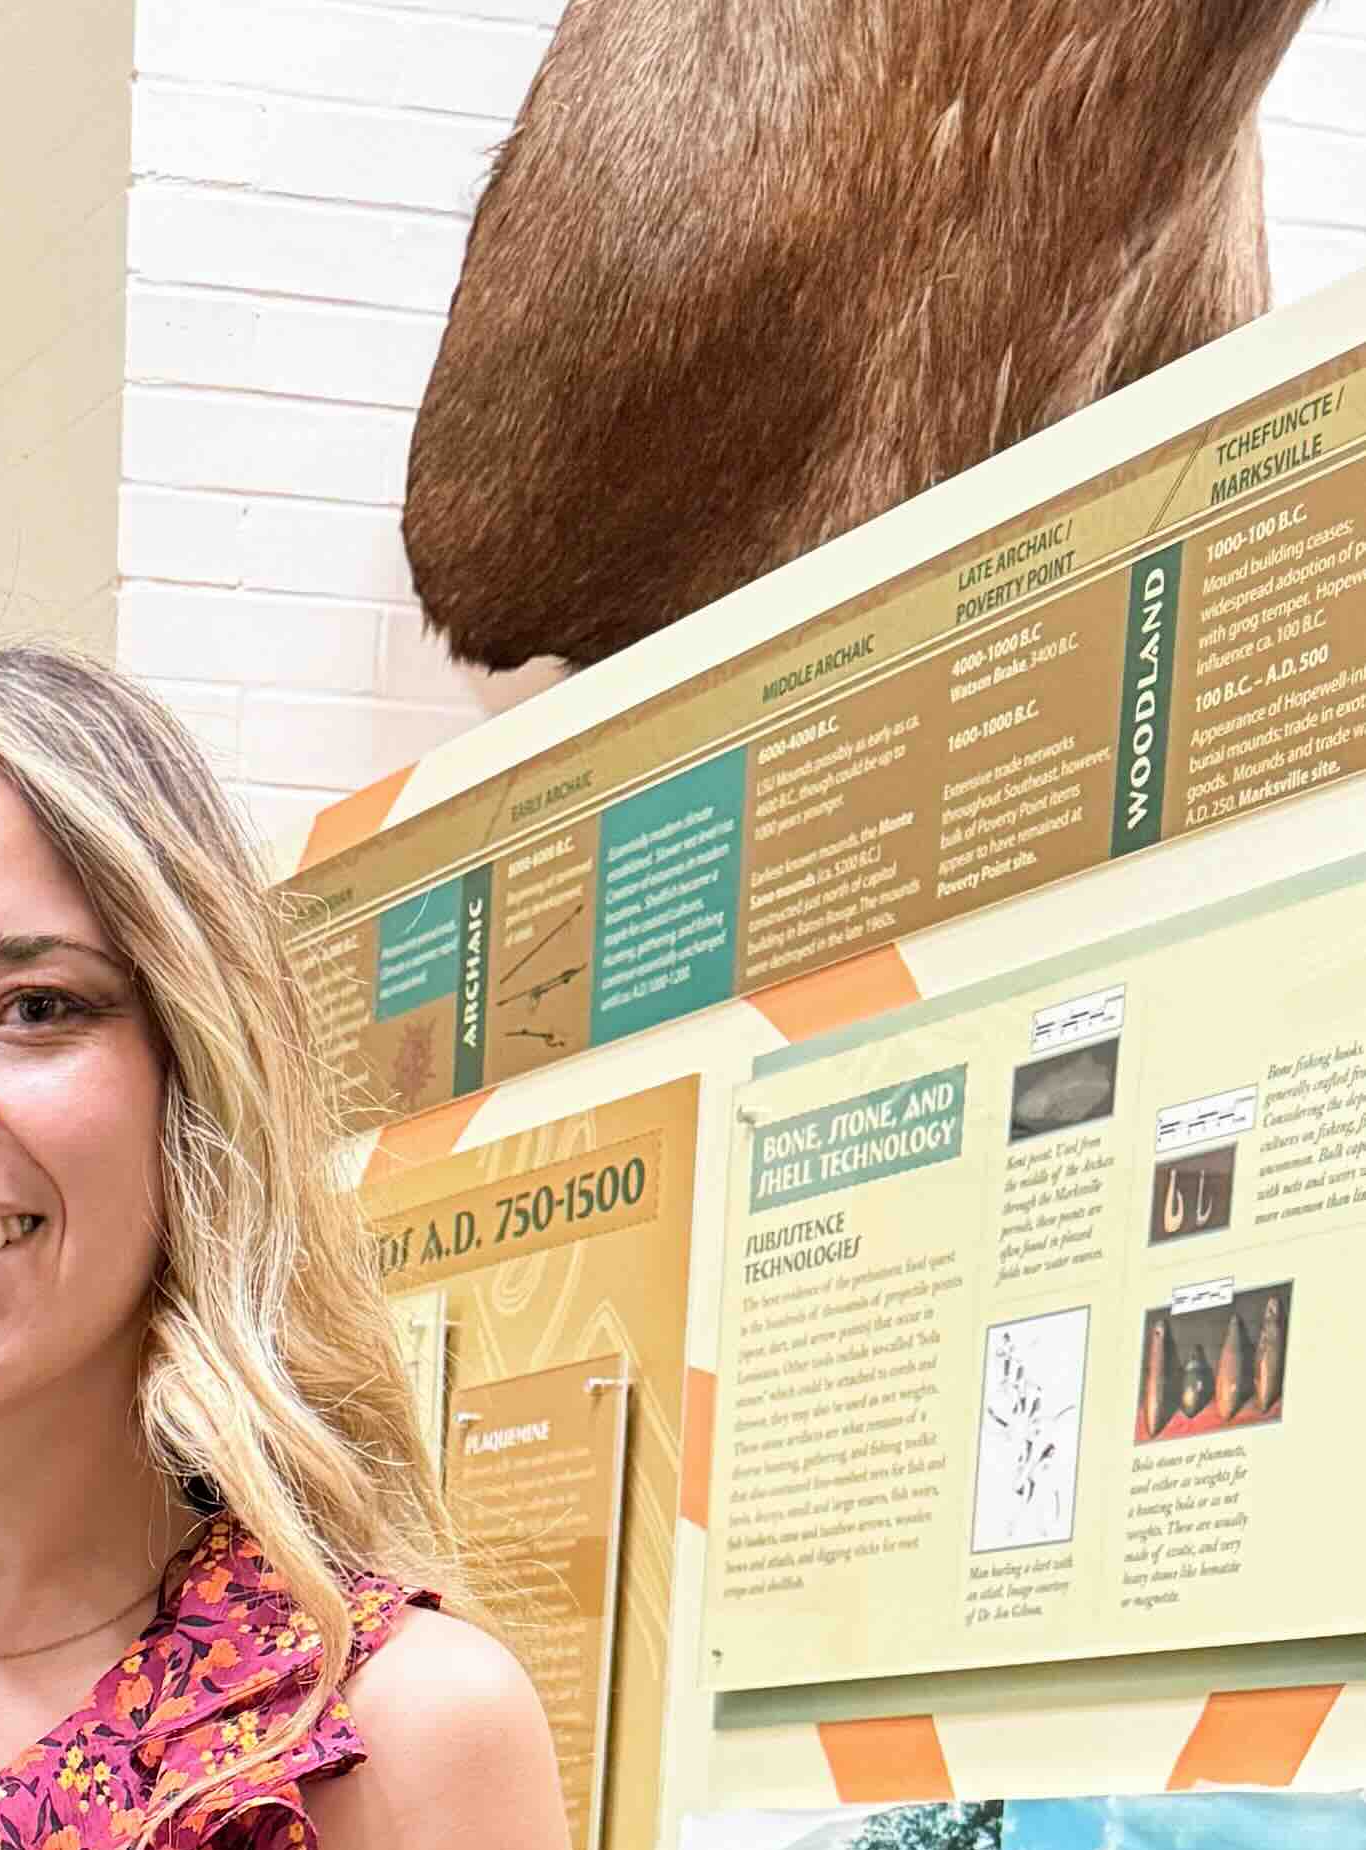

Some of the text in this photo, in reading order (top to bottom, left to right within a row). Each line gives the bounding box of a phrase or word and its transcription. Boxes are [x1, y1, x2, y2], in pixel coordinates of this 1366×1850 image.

[1217, 392, 1332, 467] TCHEFUNCTE
[1210, 434, 1323, 504] MARKSVILLE
[958, 557, 994, 592] LATE
[996, 526, 1063, 574] ARCHAIC
[1207, 504, 1308, 562] 1000-100 B.C.
[956, 550, 1076, 625] POVERTY POINT
[1201, 581, 1275, 622] widespread
[1275, 554, 1337, 593] adoption
[1339, 546, 1354, 568] of
[1203, 561, 1248, 596] Mound
[1250, 539, 1304, 574] building
[951, 635, 1018, 678] 4000-1000
[1196, 644, 1254, 676] influence
[1277, 619, 1300, 643] 100
[1198, 627, 1225, 648] with
[1229, 614, 1259, 640] grog
[762, 633, 875, 705] MIDDLE ARCHAIC
[949, 667, 991, 703] Watson
[1127, 567, 1164, 829] WOODLAND
[1196, 690, 1220, 712] 100
[1299, 644, 1328, 670] 500
[948, 713, 1012, 753] 1600-1000
[1188, 746, 1225, 773] burial
[1284, 705, 1317, 737] trade
[1320, 699, 1334, 723] in
[1190, 706, 1266, 747] Appearance
[1268, 696, 1284, 717] of
[943, 735, 1075, 800] Extensive trade networks
[1232, 750, 1284, 784] Mounds
[1287, 740, 1313, 763] and
[1316, 725, 1350, 751] trade
[940, 783, 1081, 849] bulk of Poverty Point items
[941, 789, 1000, 825] throughout
[1239, 770, 1309, 808] Marksville
[938, 806, 1083, 876] appear to have remained at
[936, 867, 980, 899] Poverty
[982, 856, 1011, 884] Point
[462, 898, 483, 1048] ARCHAIC
[903, 1083, 954, 1121] AND
[756, 1119, 956, 1199] SHELL TECHNOLOGY
[420, 1211, 482, 1265] A.D.
[493, 1157, 645, 1243] 750-1500
[744, 1235, 863, 1284] TECHNOLOGIES
